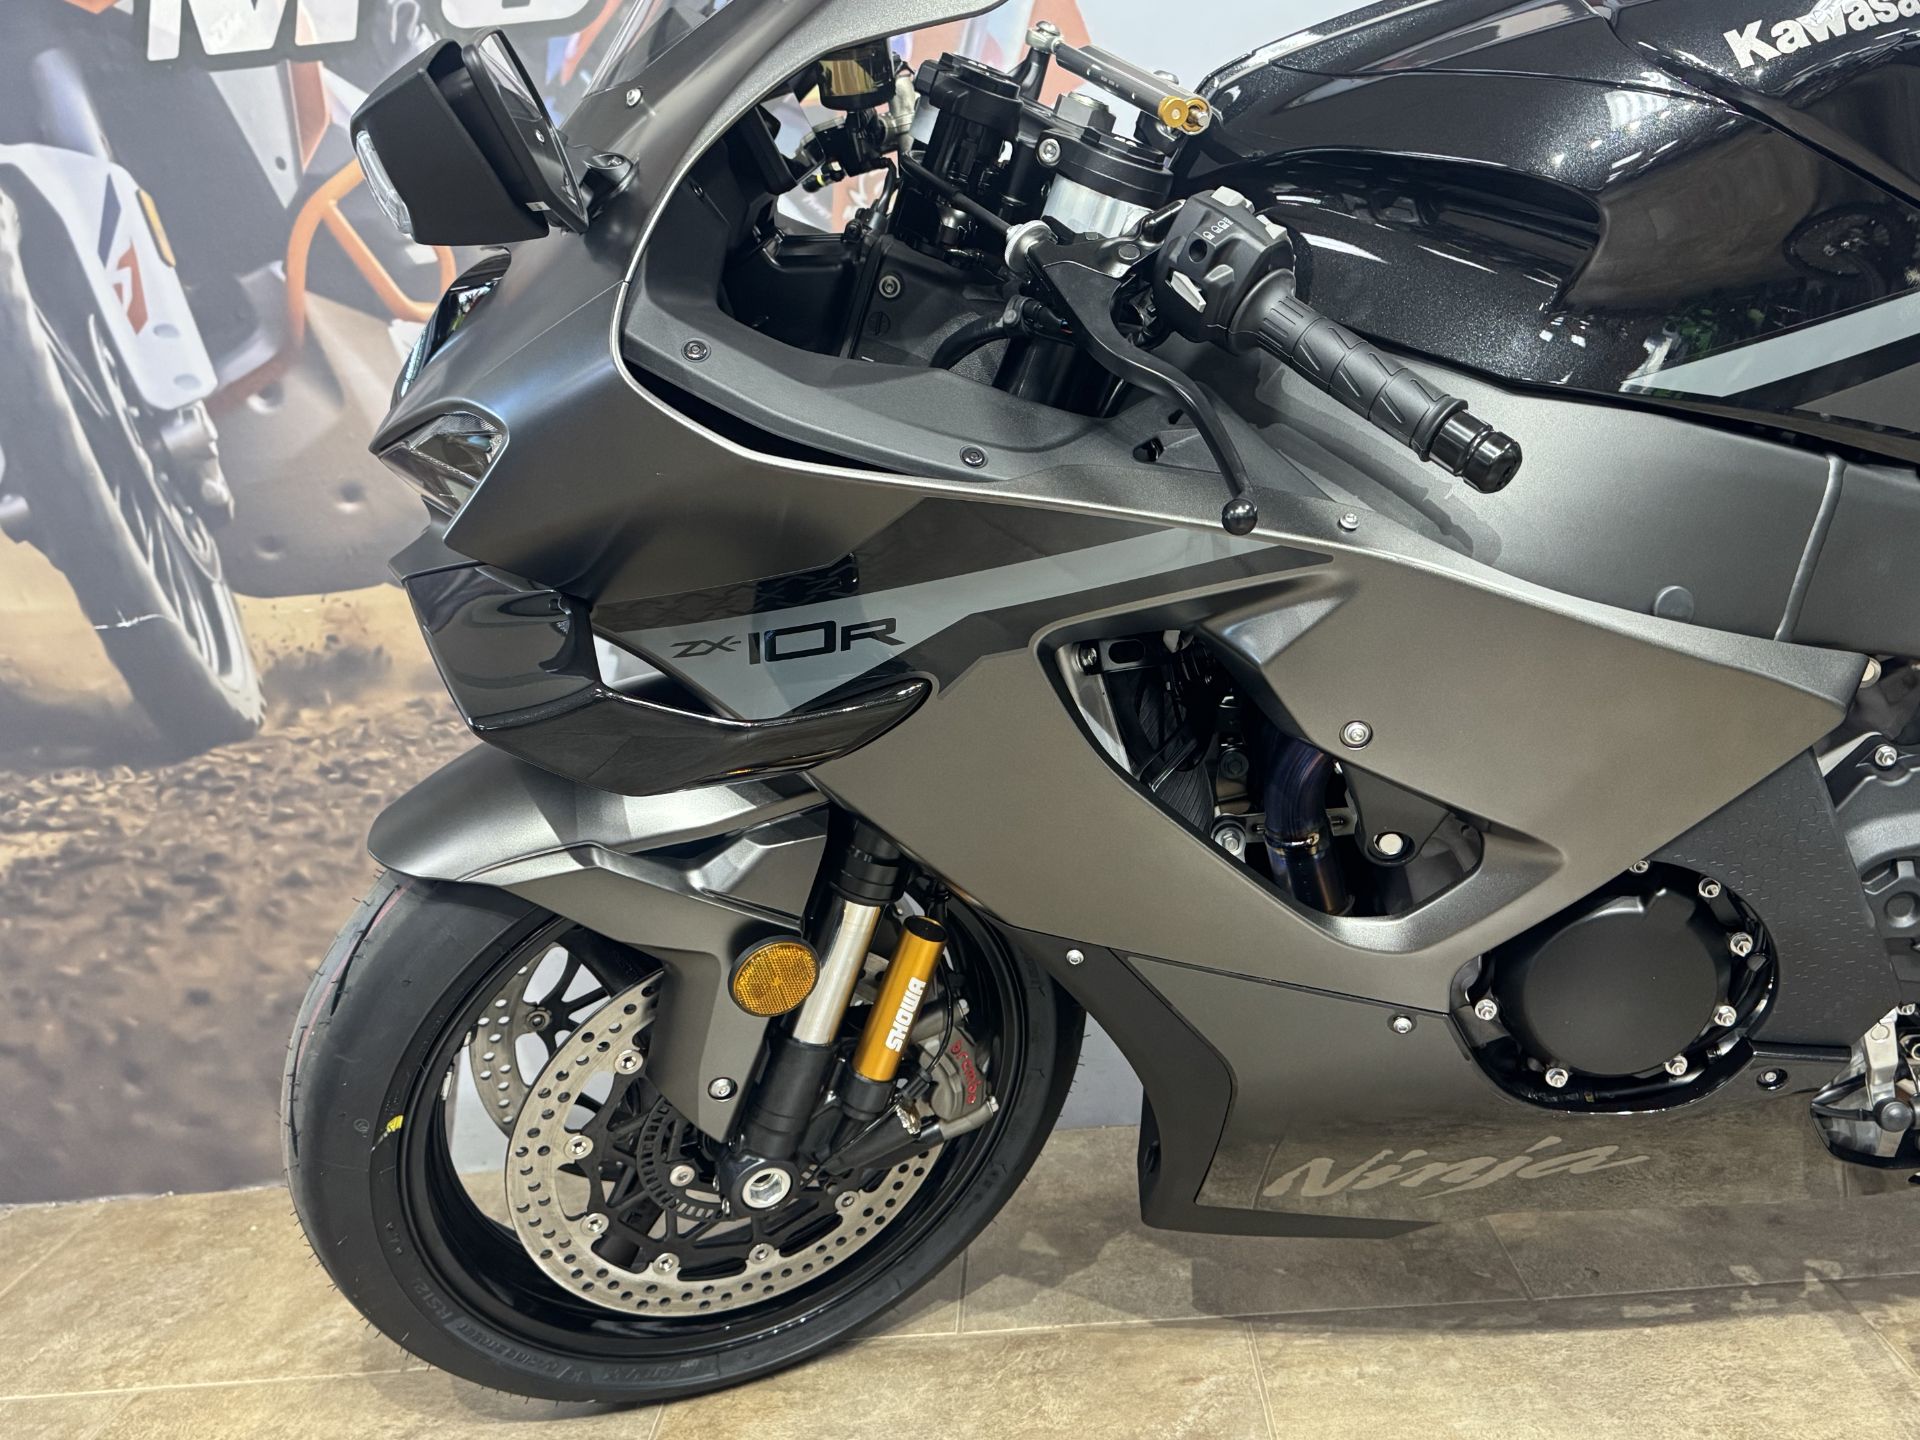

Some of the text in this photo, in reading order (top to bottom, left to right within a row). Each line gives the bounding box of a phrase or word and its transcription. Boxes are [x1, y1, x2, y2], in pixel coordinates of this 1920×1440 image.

[669, 617, 905, 664] ZX-10R
[886, 977, 926, 1052] SHOWA
[951, 1040, 982, 1104] brembo
[1263, 1136, 1650, 1199] Ninja
